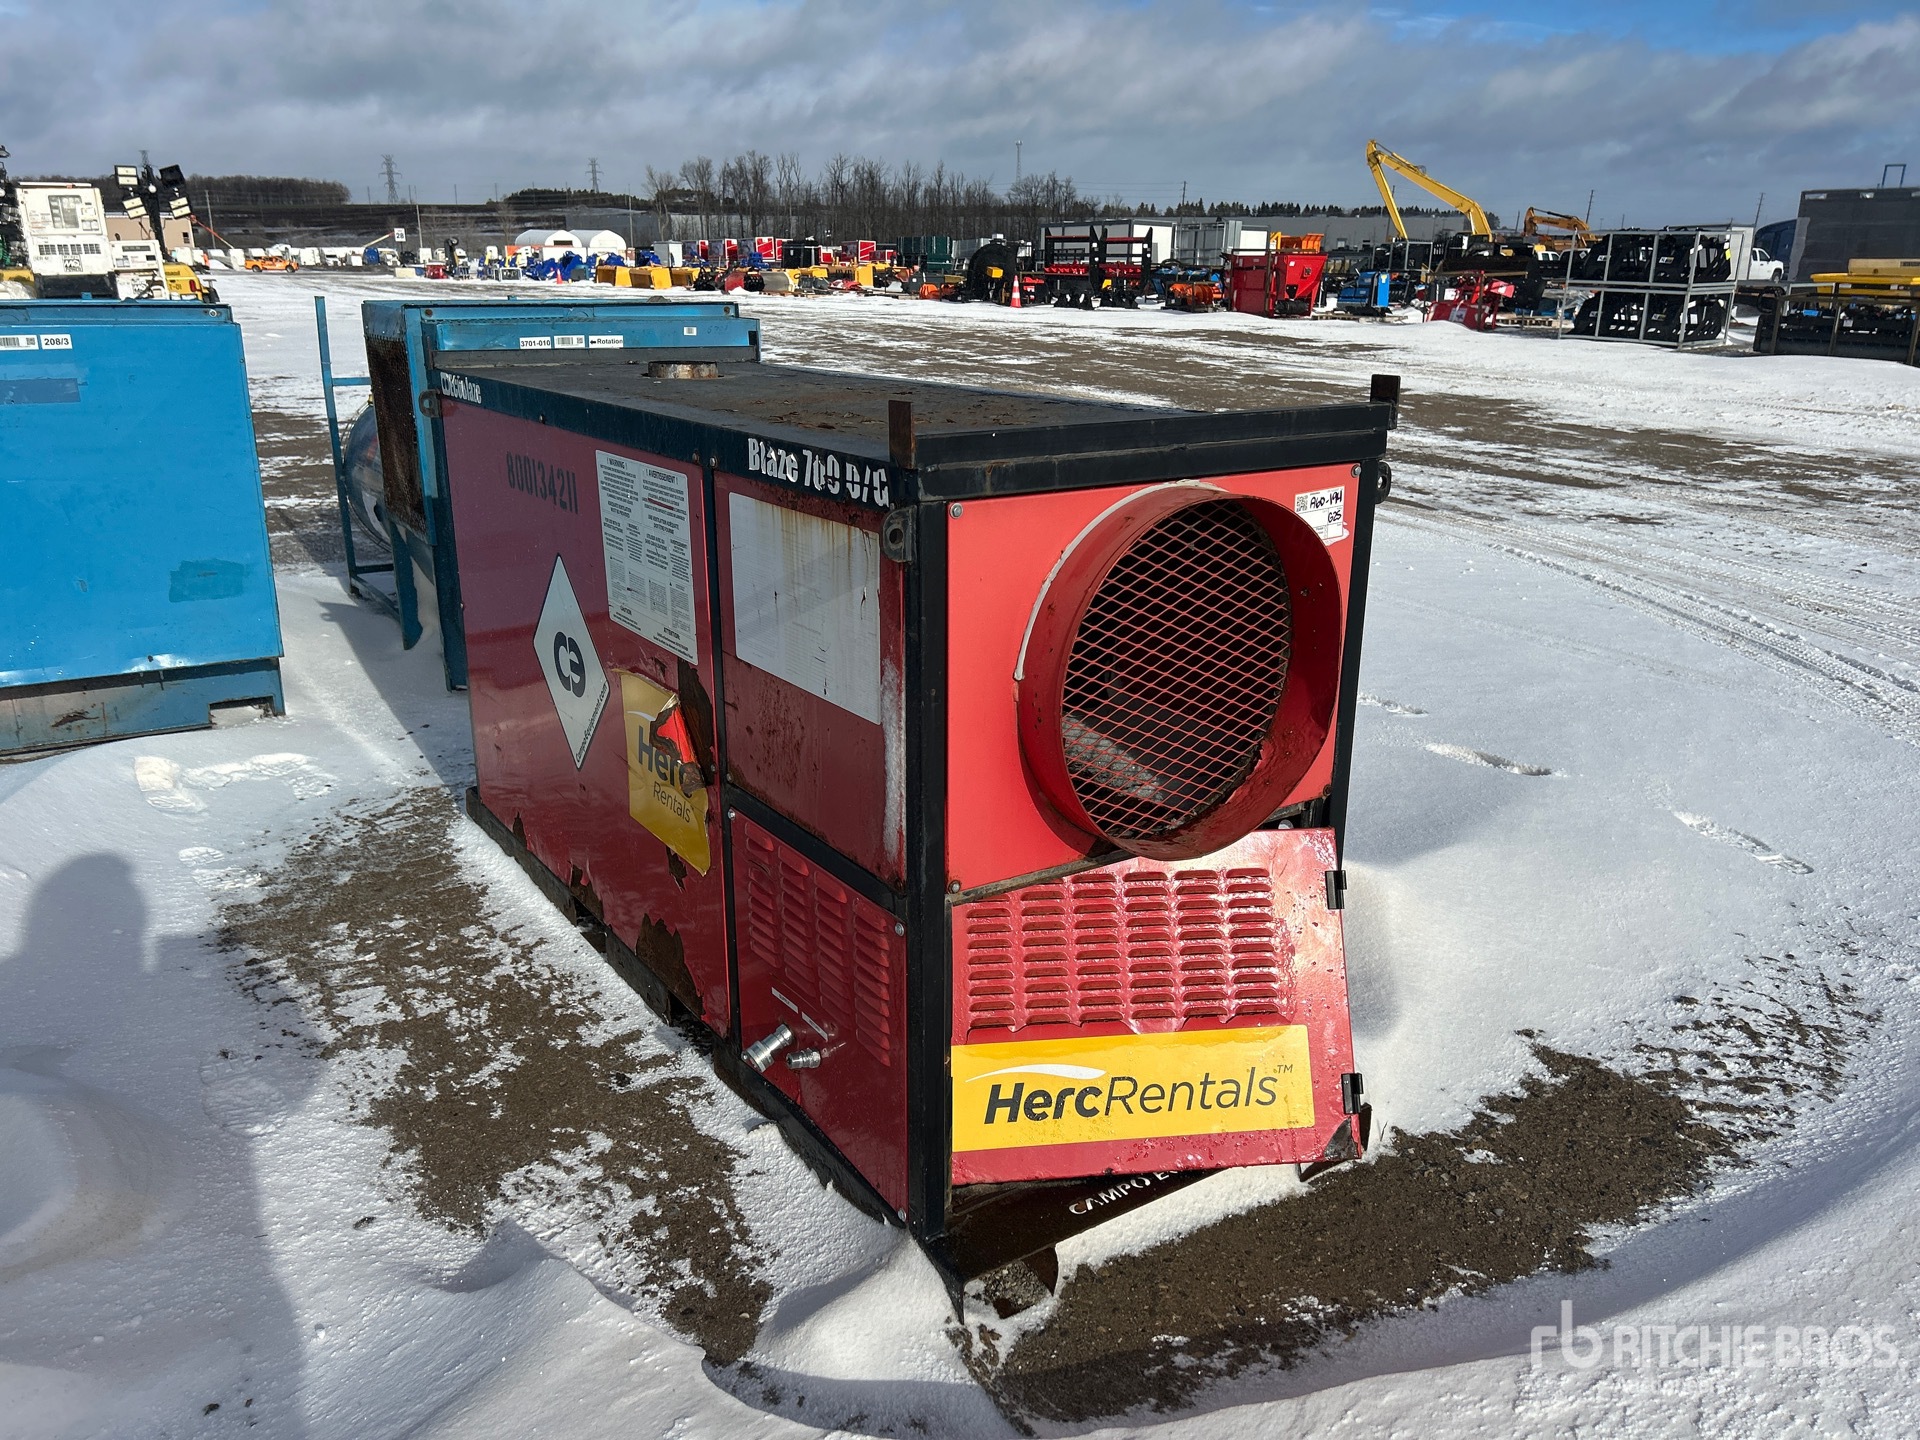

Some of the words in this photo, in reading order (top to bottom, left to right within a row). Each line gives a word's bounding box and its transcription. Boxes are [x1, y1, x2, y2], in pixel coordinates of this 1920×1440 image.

[44, 337, 69, 346] 208/3
[748, 438, 799, 483] Blaze
[653, 780, 691, 823] Rentals
[1068, 1176, 1151, 1215] CAMPO
